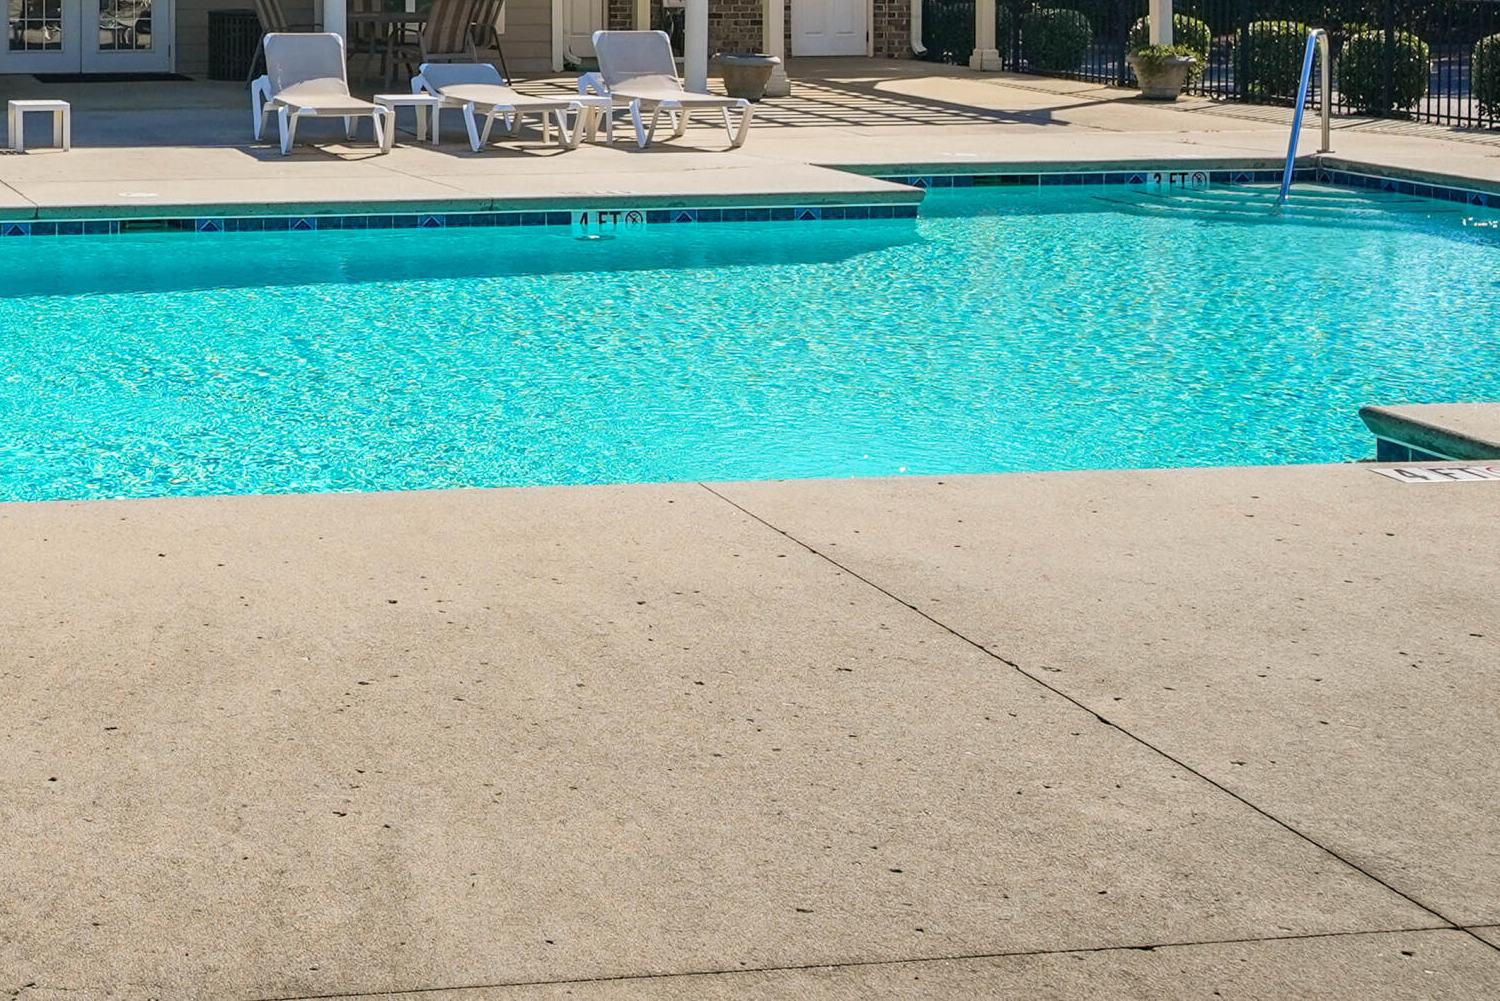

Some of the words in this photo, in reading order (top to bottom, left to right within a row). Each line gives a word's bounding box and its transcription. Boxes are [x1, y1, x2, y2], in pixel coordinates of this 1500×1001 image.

[598, 210, 622, 225] FT
[1393, 468, 1432, 481] 4
[1426, 467, 1489, 480] FT
